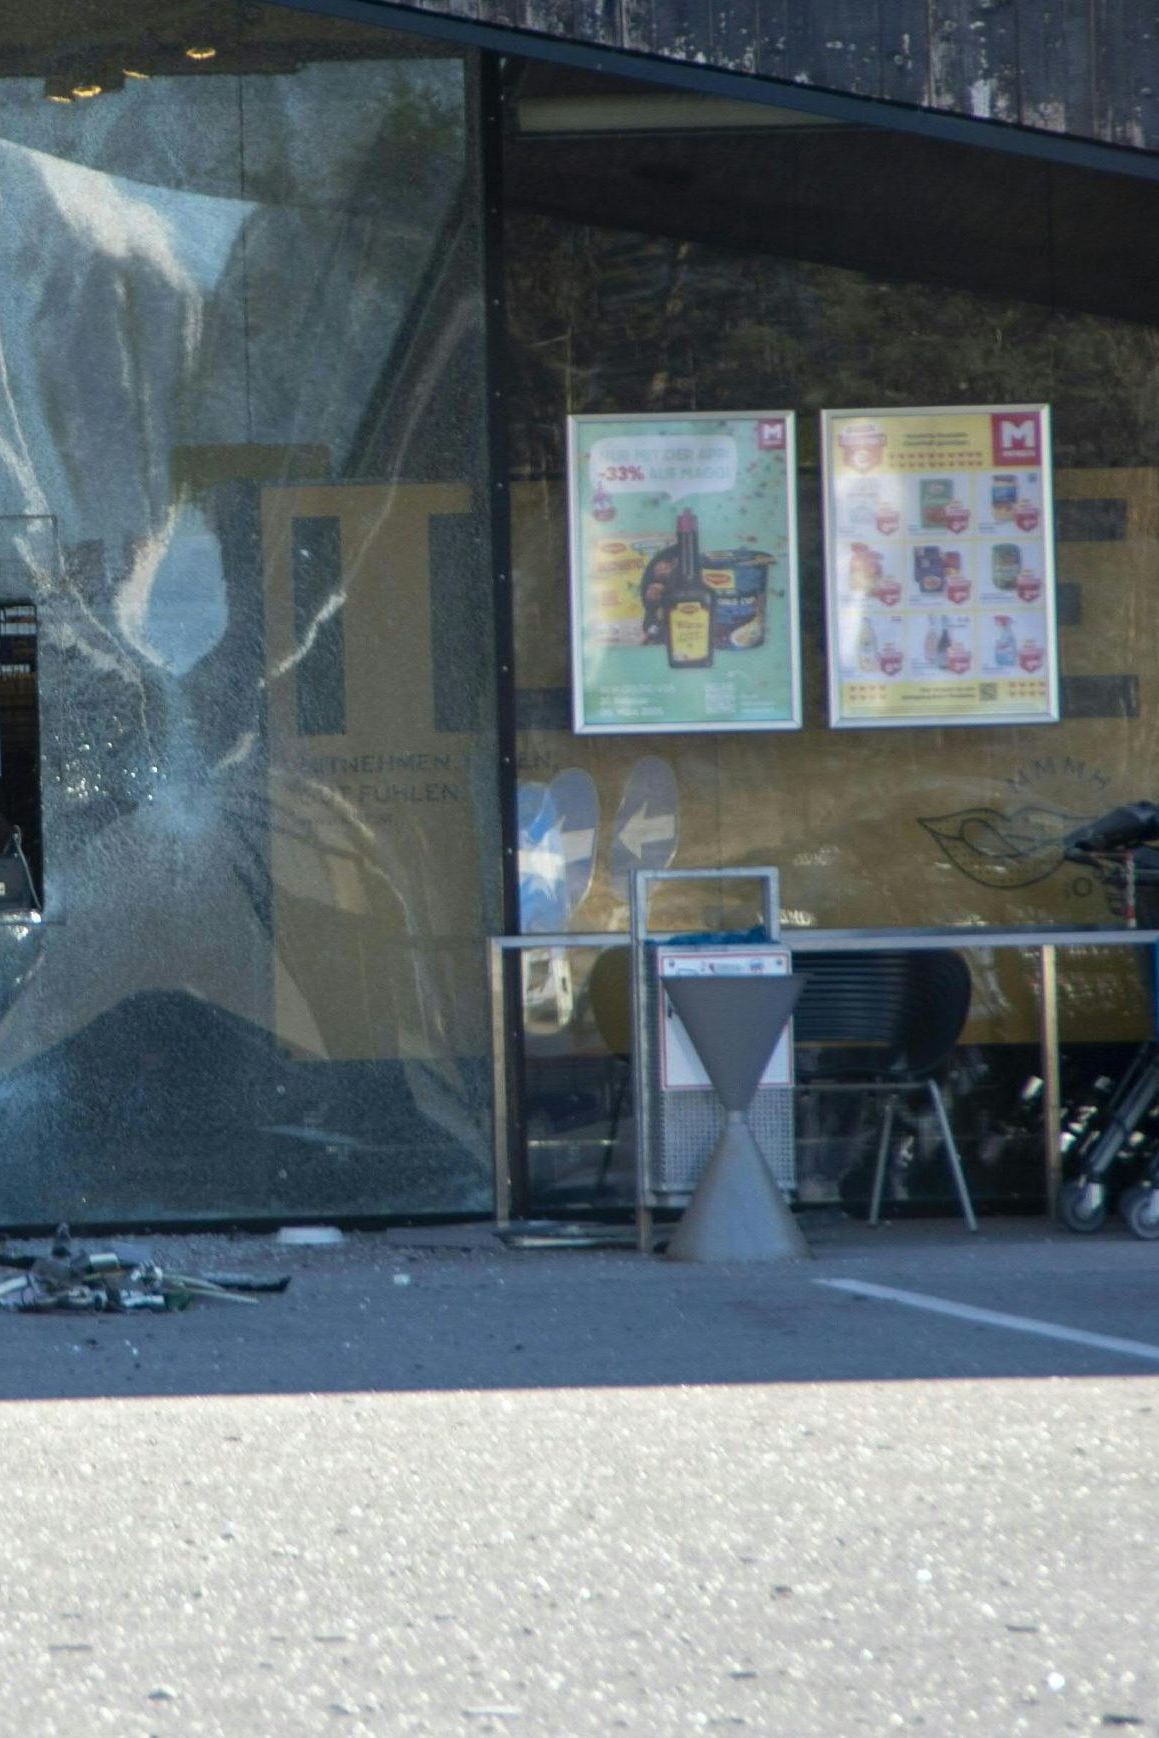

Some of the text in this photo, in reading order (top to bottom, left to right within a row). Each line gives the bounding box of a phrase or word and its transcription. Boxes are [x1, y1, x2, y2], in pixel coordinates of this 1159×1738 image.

[762, 423, 783, 440] M
[1001, 420, 1036, 447] M
[599, 465, 644, 481] -33%
